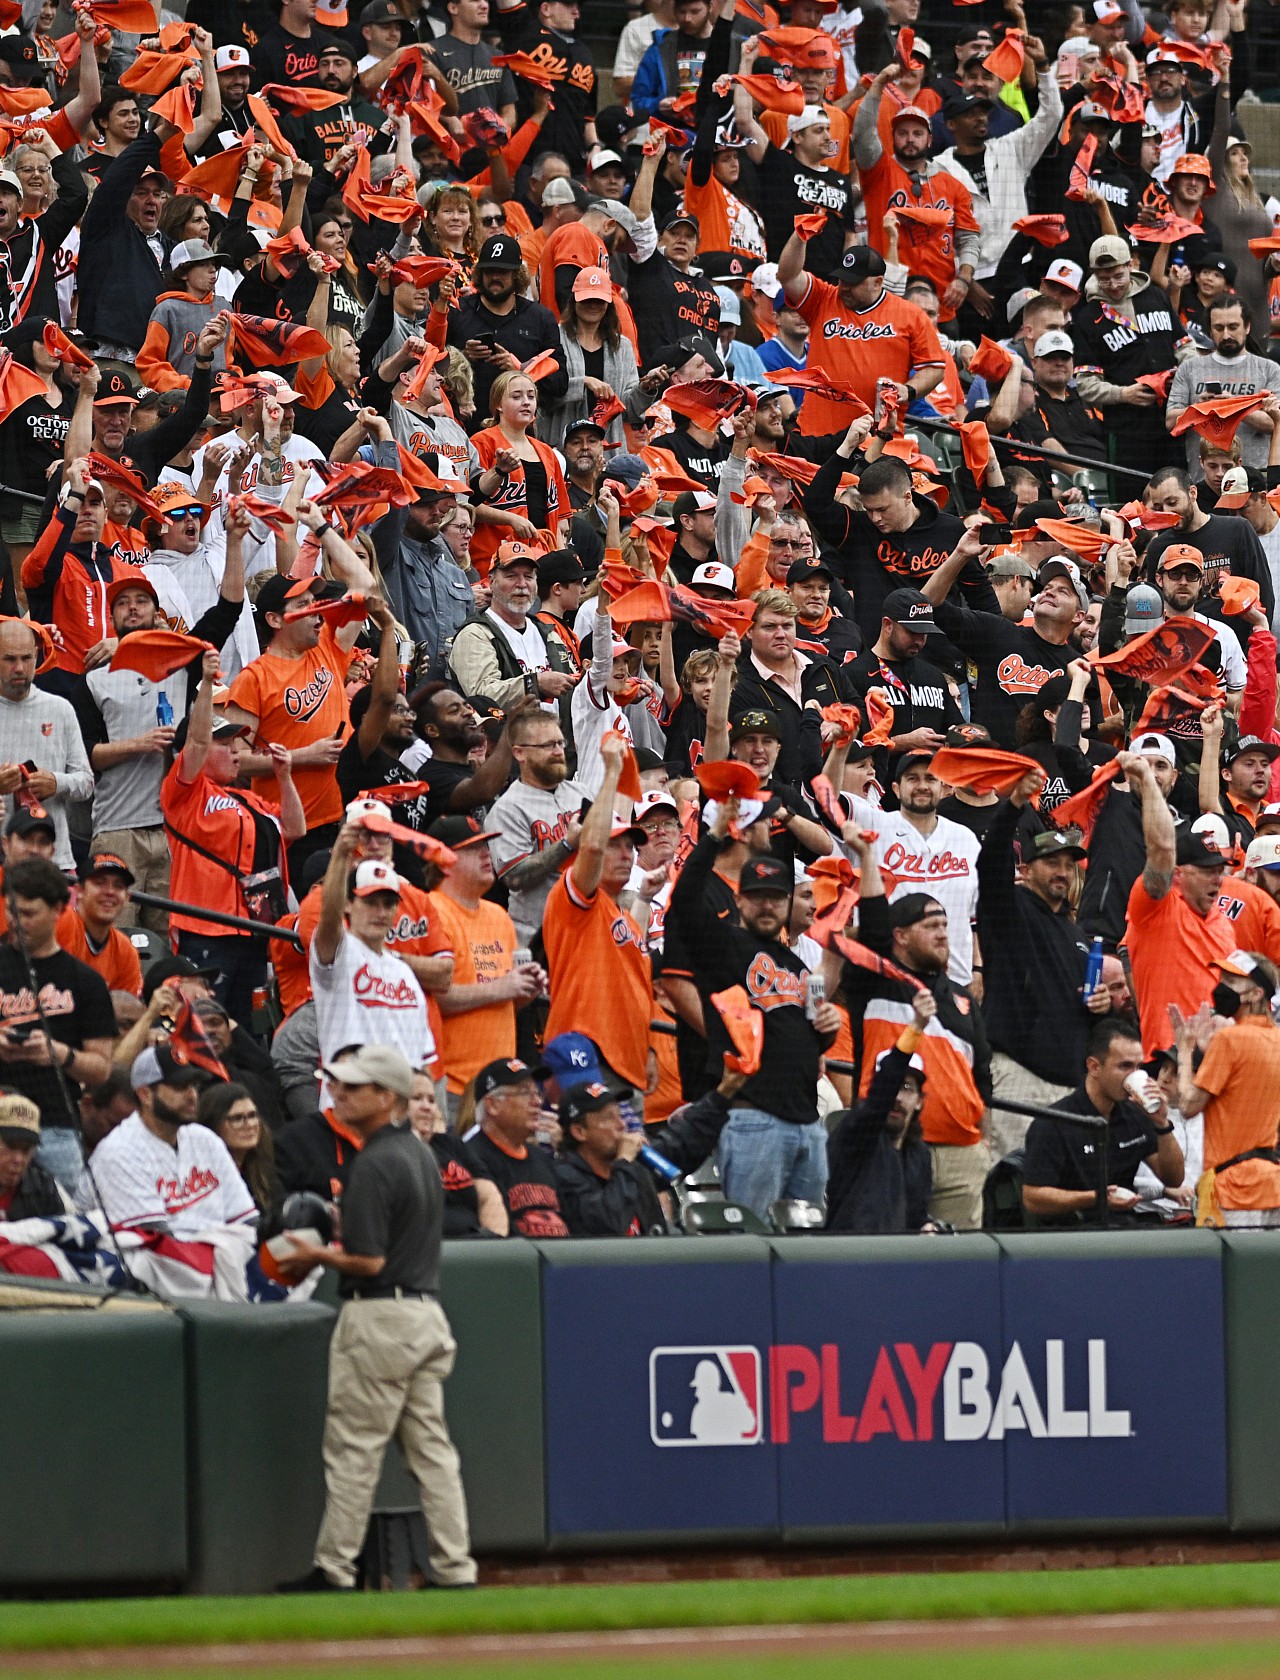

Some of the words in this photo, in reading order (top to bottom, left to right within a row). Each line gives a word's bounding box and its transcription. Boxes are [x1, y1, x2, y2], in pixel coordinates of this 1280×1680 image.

[285, 53, 319, 77] Orio
[491, 243, 504, 259] B
[942, 232, 951, 254] 3
[823, 318, 895, 340] Orioles
[1197, 382, 1256, 395] OOLES
[26, 415, 71, 429] OCTOB
[33, 426, 67, 440] READ
[876, 540, 951, 573] Orioles
[87, 585, 95, 627] MAMMU
[284, 666, 332, 717] Orioles
[884, 843, 969, 877] Orioles
[385, 917, 428, 942] oles
[570, 1049, 589, 1069] KC
[769, 1339, 1132, 1444] PLAYBALL
